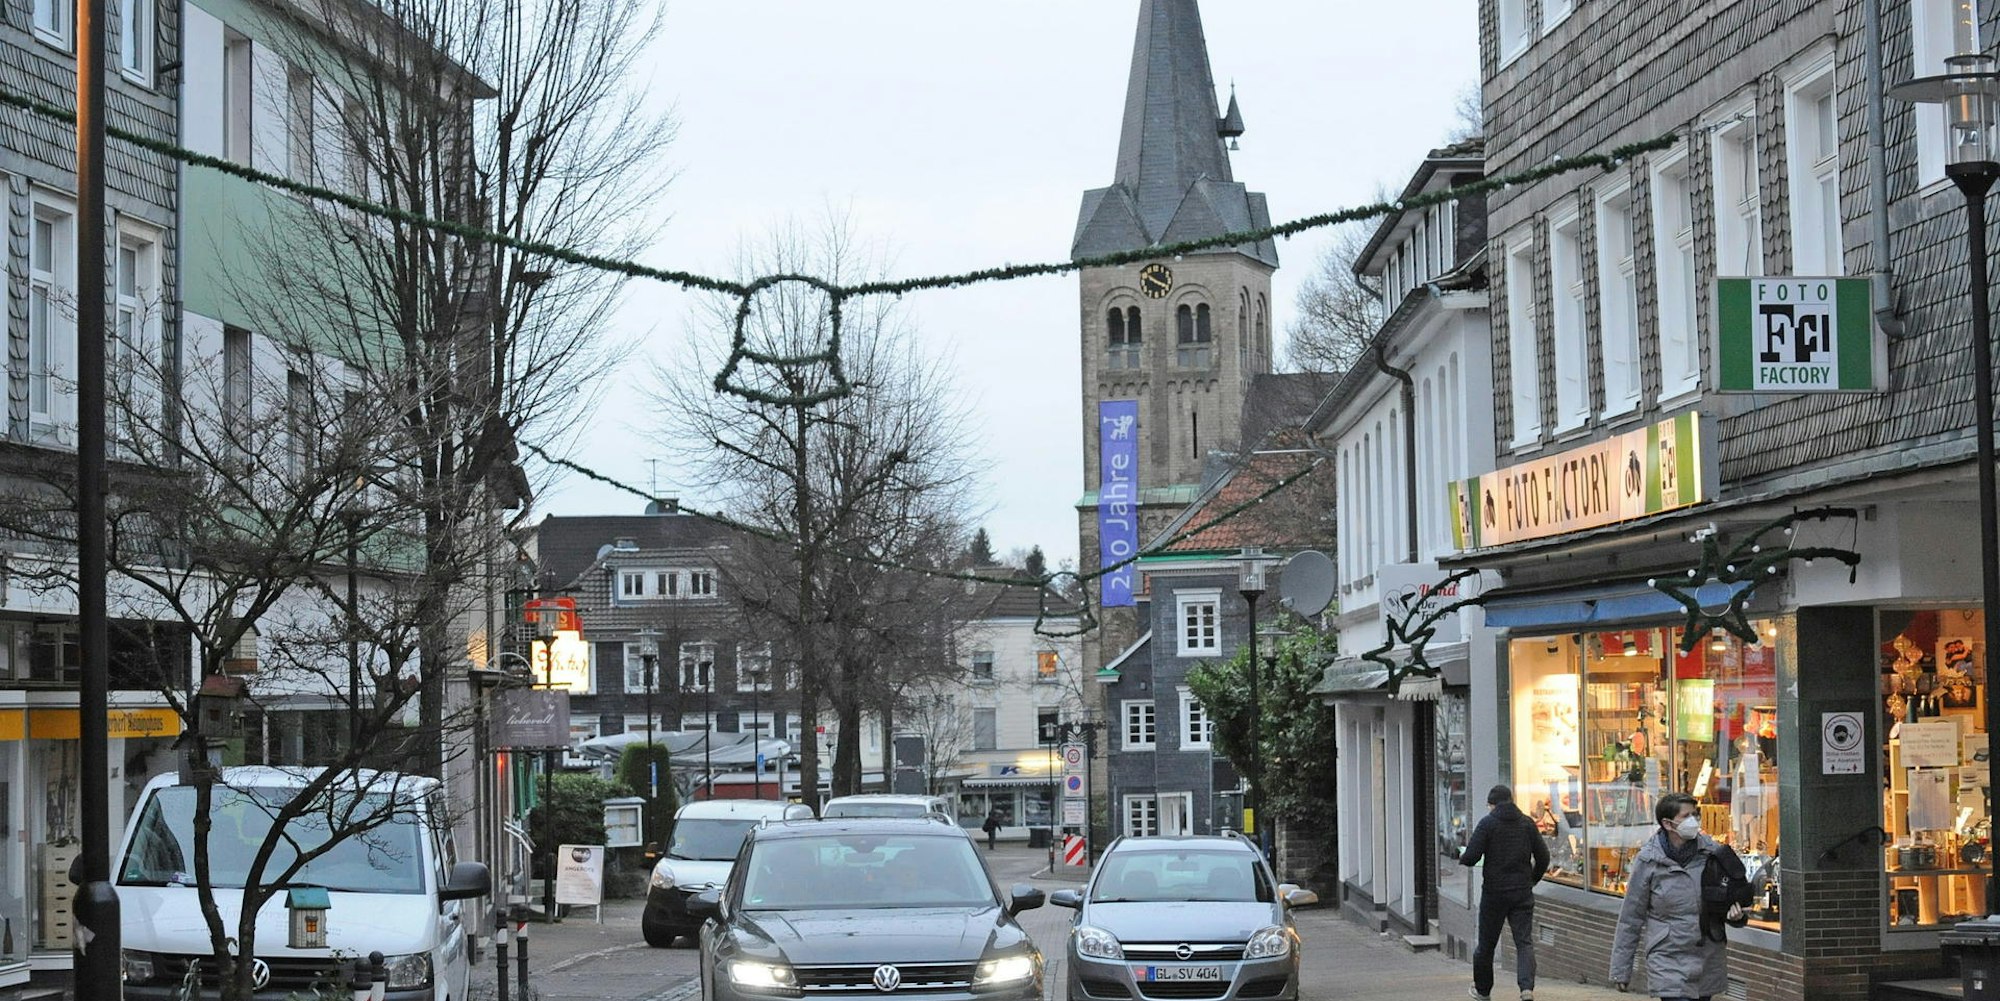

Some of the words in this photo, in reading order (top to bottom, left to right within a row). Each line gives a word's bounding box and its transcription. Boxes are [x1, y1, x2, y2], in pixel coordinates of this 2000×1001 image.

[1759, 283, 1828, 301] FOTO
[1760, 366, 1831, 384] FACTORY
[1104, 453, 1129, 531] Jahre
[1505, 470, 1540, 532] FOTO
[1545, 451, 1610, 525] FACTORY
[1421, 600, 1437, 610] Der
[1156, 968, 1171, 979] GL
[1178, 968, 1194, 979] SV
[1196, 967, 1218, 979] 404
